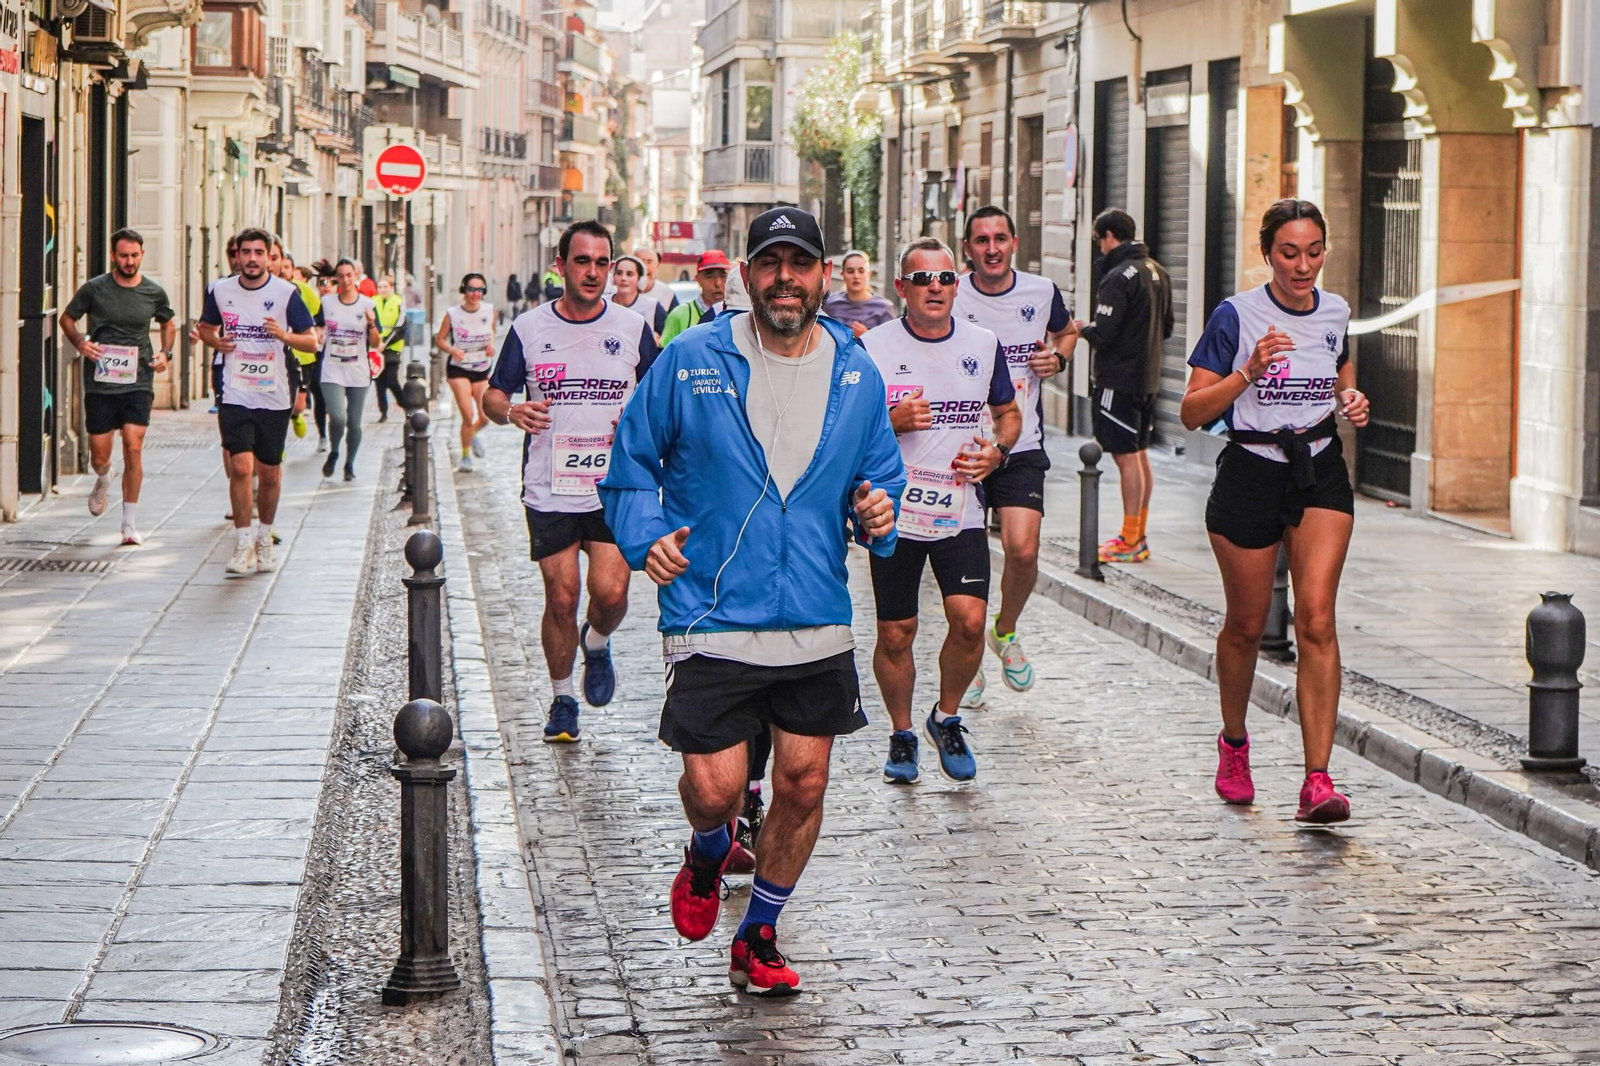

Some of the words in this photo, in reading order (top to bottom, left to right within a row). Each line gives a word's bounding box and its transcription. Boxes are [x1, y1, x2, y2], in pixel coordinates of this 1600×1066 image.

[769, 223, 796, 231] adidas
[104, 357, 129, 367] 794
[240, 363, 269, 374] 790
[537, 364, 565, 380] 10ª
[690, 368, 721, 376] ZURICH
[1267, 361, 1289, 376] 0ª
[538, 378, 628, 391] CARRERA
[692, 386, 723, 395] SEVILLA
[565, 453, 607, 469] 246
[912, 469, 954, 481] CARRERA
[905, 487, 953, 508] 834
